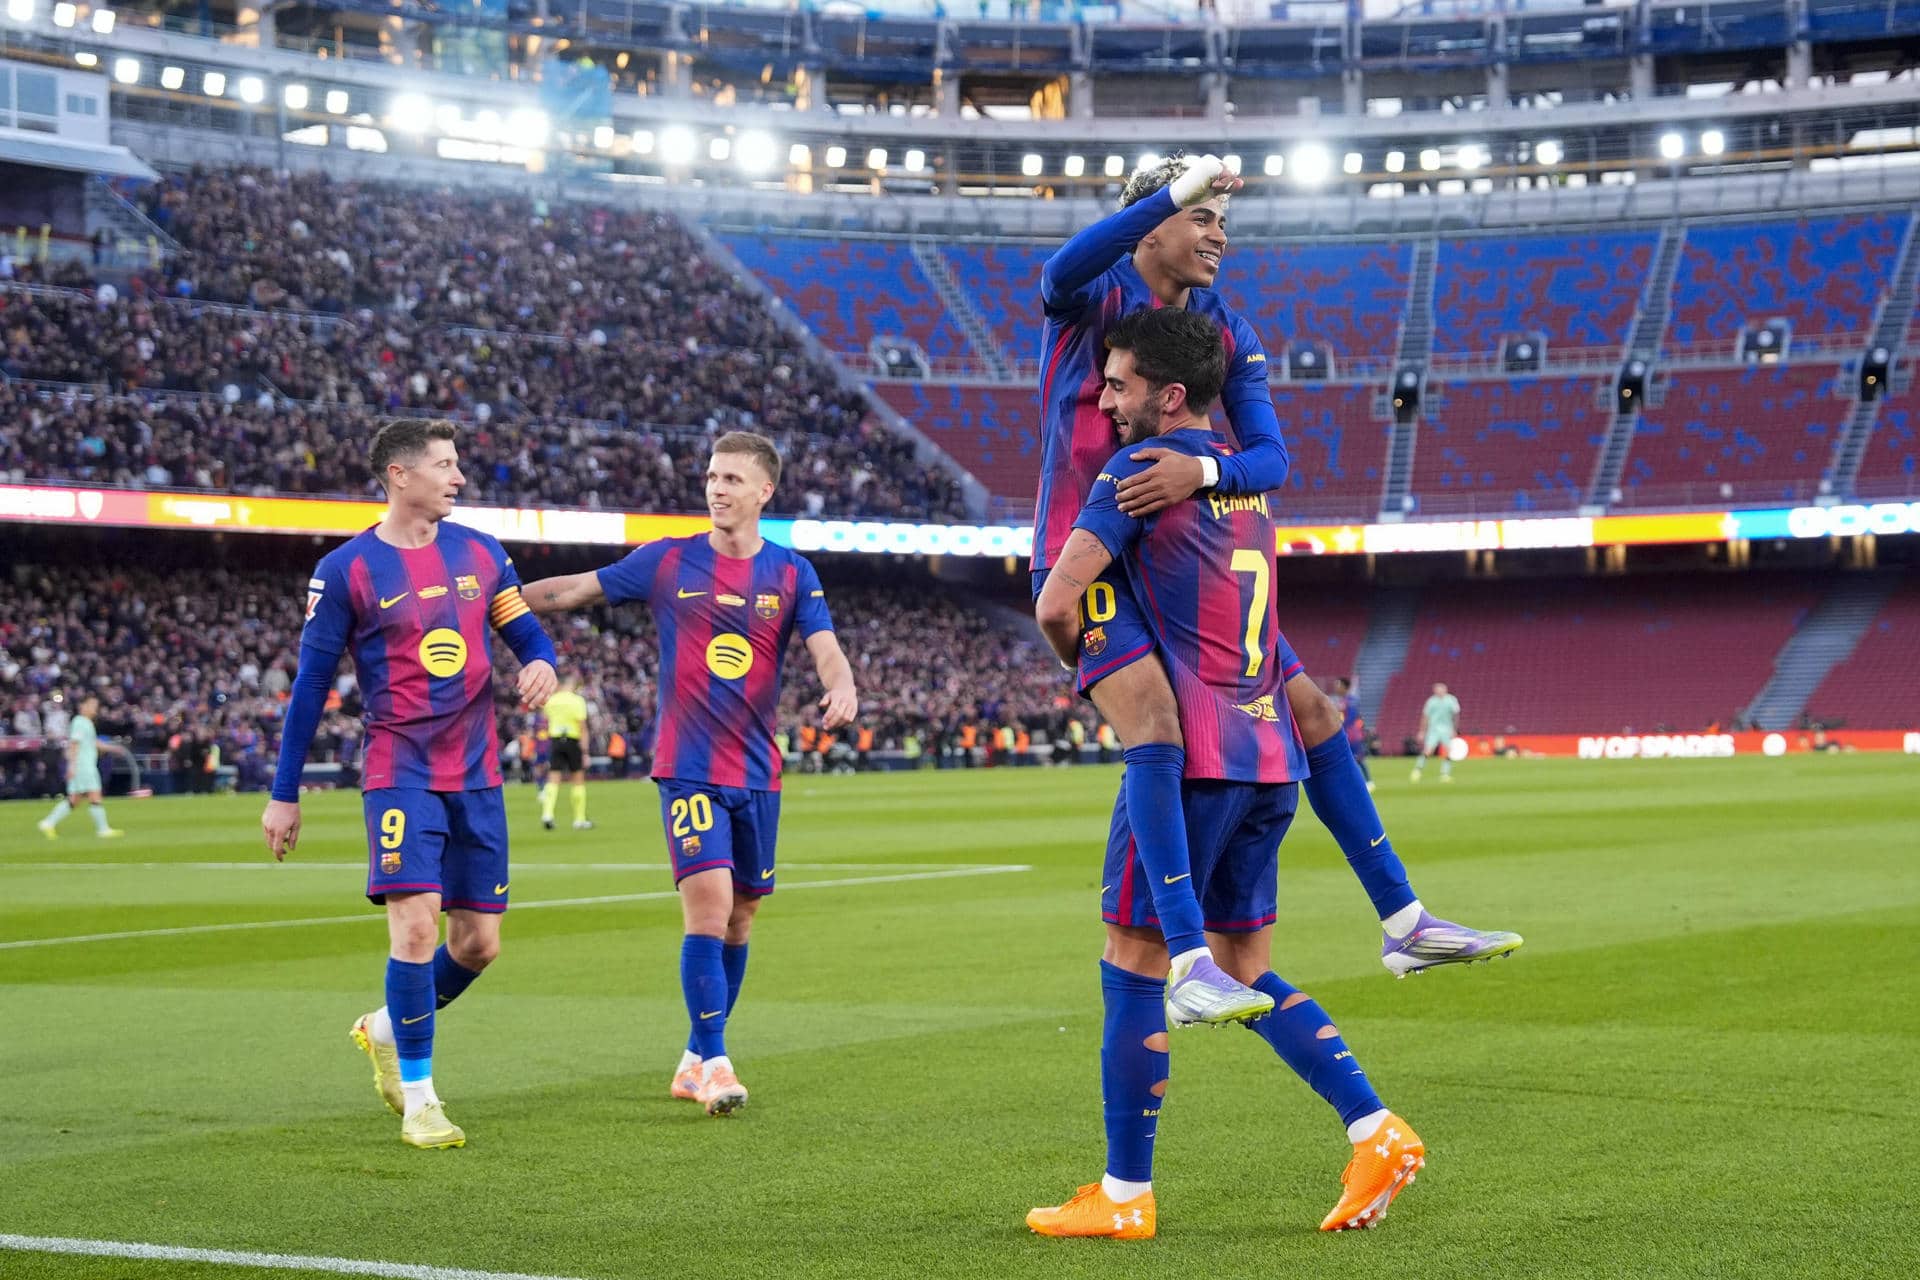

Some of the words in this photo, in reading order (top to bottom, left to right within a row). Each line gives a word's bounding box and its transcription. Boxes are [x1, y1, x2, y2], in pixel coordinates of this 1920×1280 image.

[1230, 549, 1269, 677] 7
[381, 808, 406, 849] 9
[671, 793, 713, 838] 20
